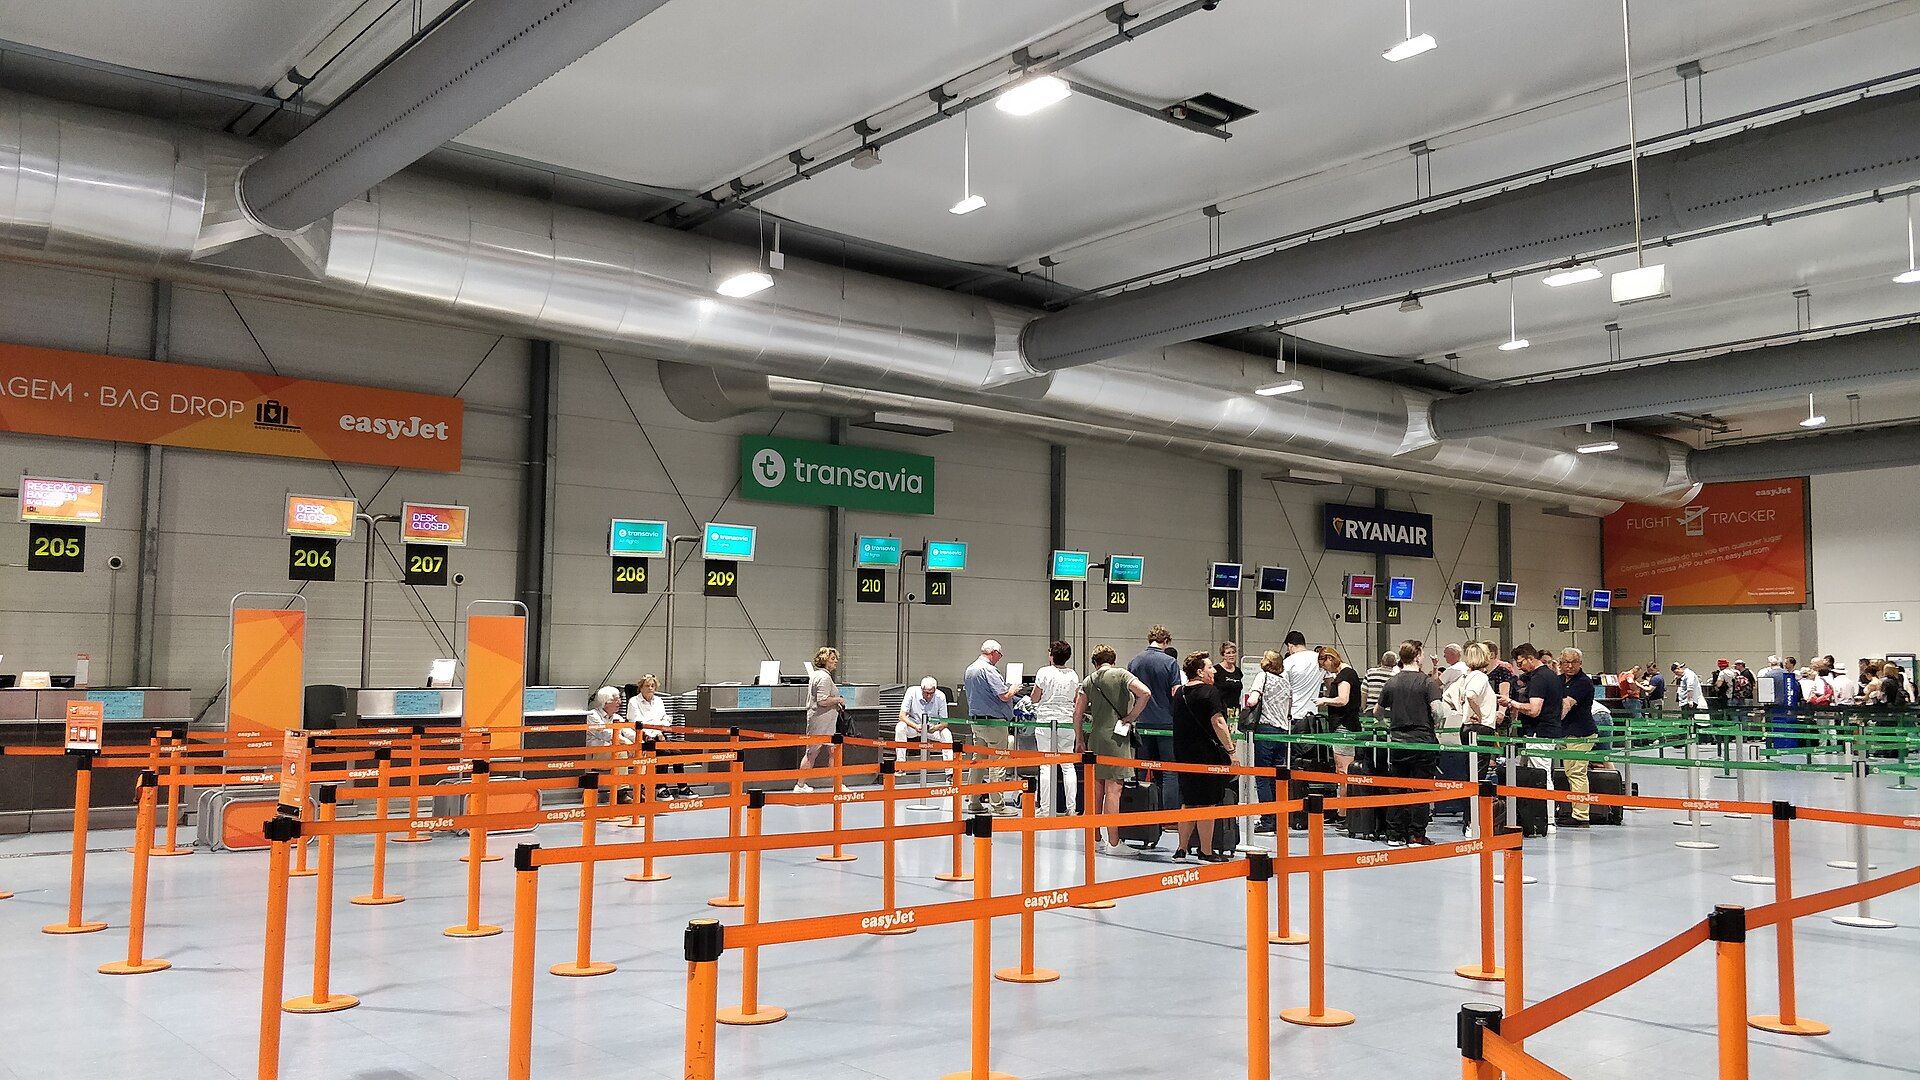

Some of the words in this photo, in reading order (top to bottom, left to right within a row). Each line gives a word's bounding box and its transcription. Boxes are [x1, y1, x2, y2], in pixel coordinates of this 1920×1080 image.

[0, 377, 73, 402] GEM
[100, 386, 159, 411] BAG
[170, 394, 245, 419] DROP
[339, 414, 449, 441] easyJet
[793, 457, 923, 494] transavia
[296, 504, 325, 514] DESK
[412, 513, 438, 523] DESK
[1627, 516, 1671, 530] FLIGHT
[1711, 509, 1776, 524] TRACKER
[412, 521, 450, 531] CLOSED
[1345, 519, 1427, 545] RYANAIR
[35, 537, 80, 557] 205
[294, 550, 332, 568] 206
[411, 556, 444, 573] 207
[616, 566, 646, 582] 208
[707, 571, 735, 586] 209
[862, 579, 881, 592] 210
[931, 583, 946, 595] 211
[1054, 589, 1070, 601] 212
[1110, 592, 1126, 604] 213
[1211, 597, 1225, 609] 214
[1259, 600, 1272, 612] 215
[1347, 605, 1359, 615] 216
[1388, 607, 1398, 617] 217
[247, 740, 273, 748] easyJet
[632, 757, 658, 765] easyJet
[712, 752, 737, 760] easyJet
[447, 763, 474, 772] easyJe
[548, 761, 575, 769] easyJet
[1208, 765, 1230, 773] easyJet
[240, 773, 274, 783] easyJet
[348, 769, 380, 779] easyJet
[1347, 775, 1374, 784] easyJet
[930, 786, 959, 796] easyJet
[1435, 781, 1464, 789] easyJet
[834, 791, 864, 801] easyJet
[1567, 793, 1600, 802] easyJet
[669, 799, 704, 811] easyJet
[1682, 801, 1720, 809] easyJet
[546, 809, 586, 821] easyJet
[411, 818, 454, 829] easyJet
[1455, 841, 1484, 853] easyJet
[1356, 852, 1389, 865] easyJet
[1162, 870, 1200, 887] easyJet
[1024, 891, 1069, 907] easyJet
[861, 910, 915, 929] easyJet
